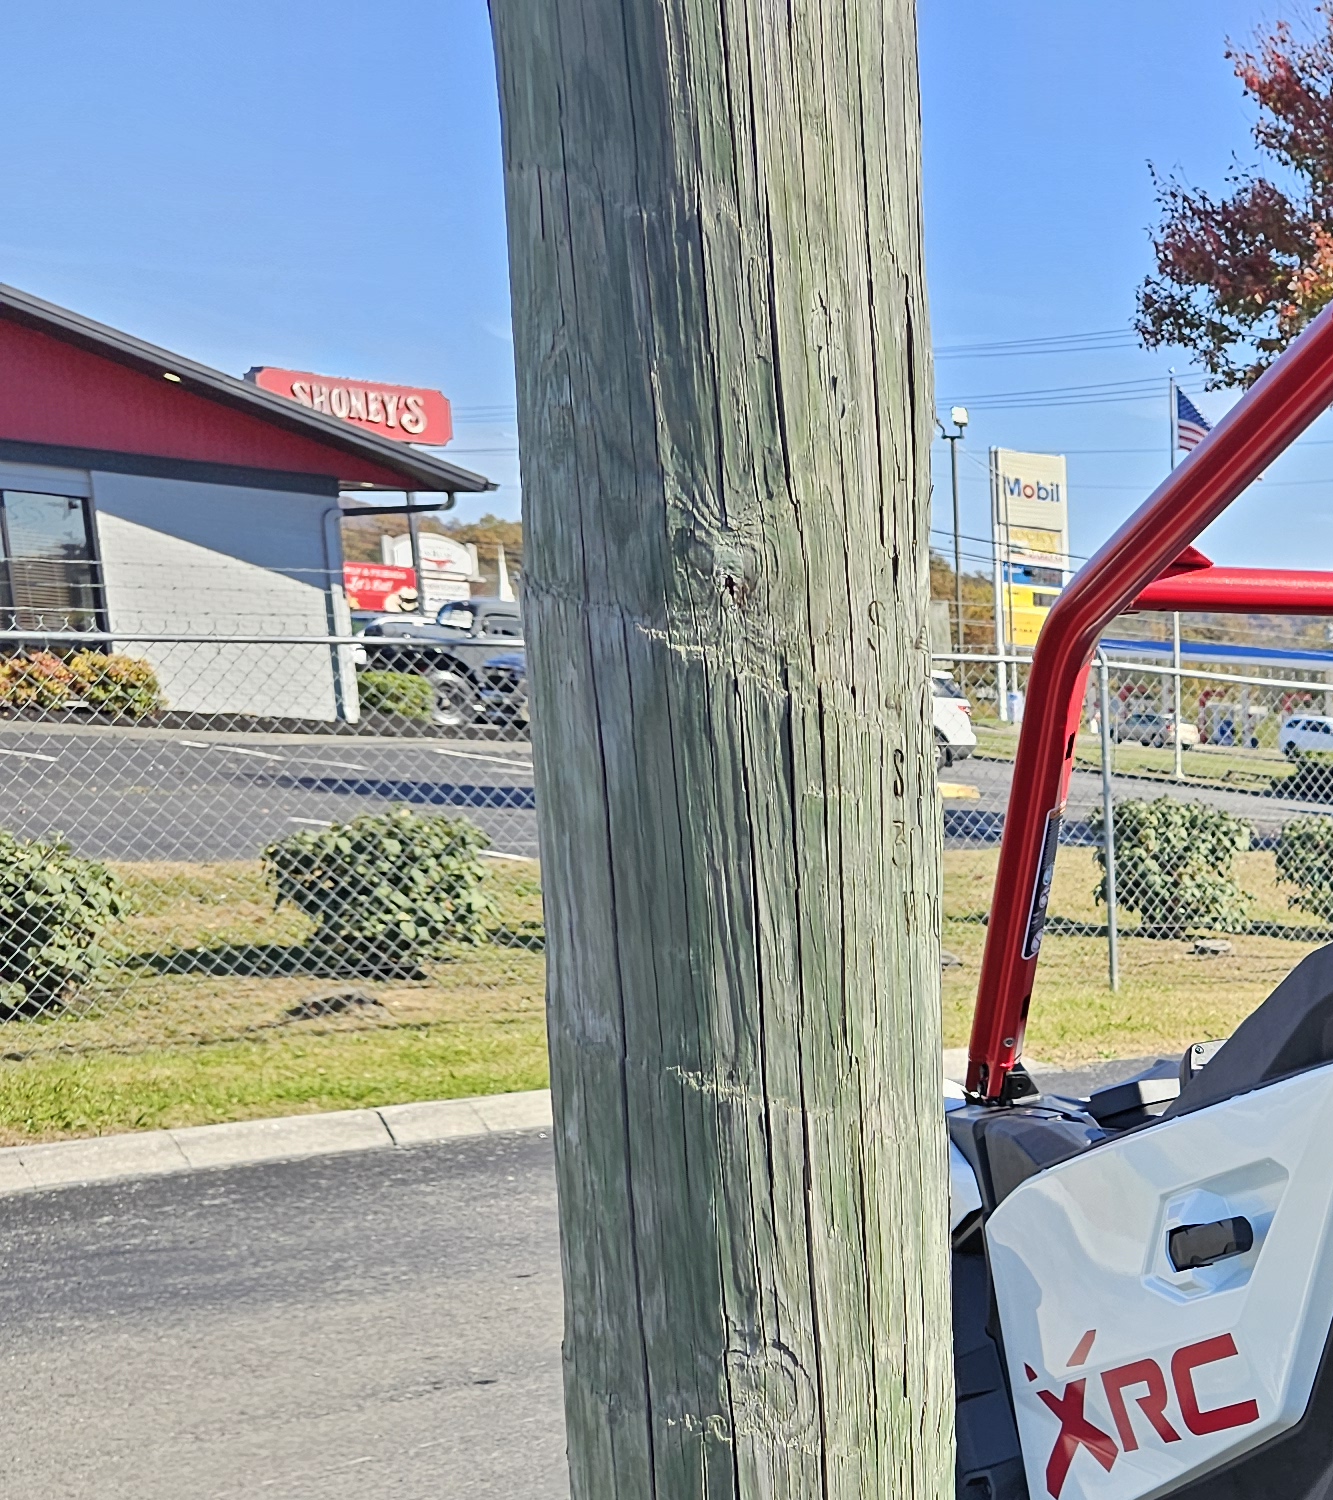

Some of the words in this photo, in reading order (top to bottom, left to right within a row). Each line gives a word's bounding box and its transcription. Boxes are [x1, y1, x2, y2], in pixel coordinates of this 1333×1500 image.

[291, 381, 428, 434] SHONEY'S
[1006, 476, 1061, 502] Mobil
[1024, 1329, 1260, 1500] XRC
